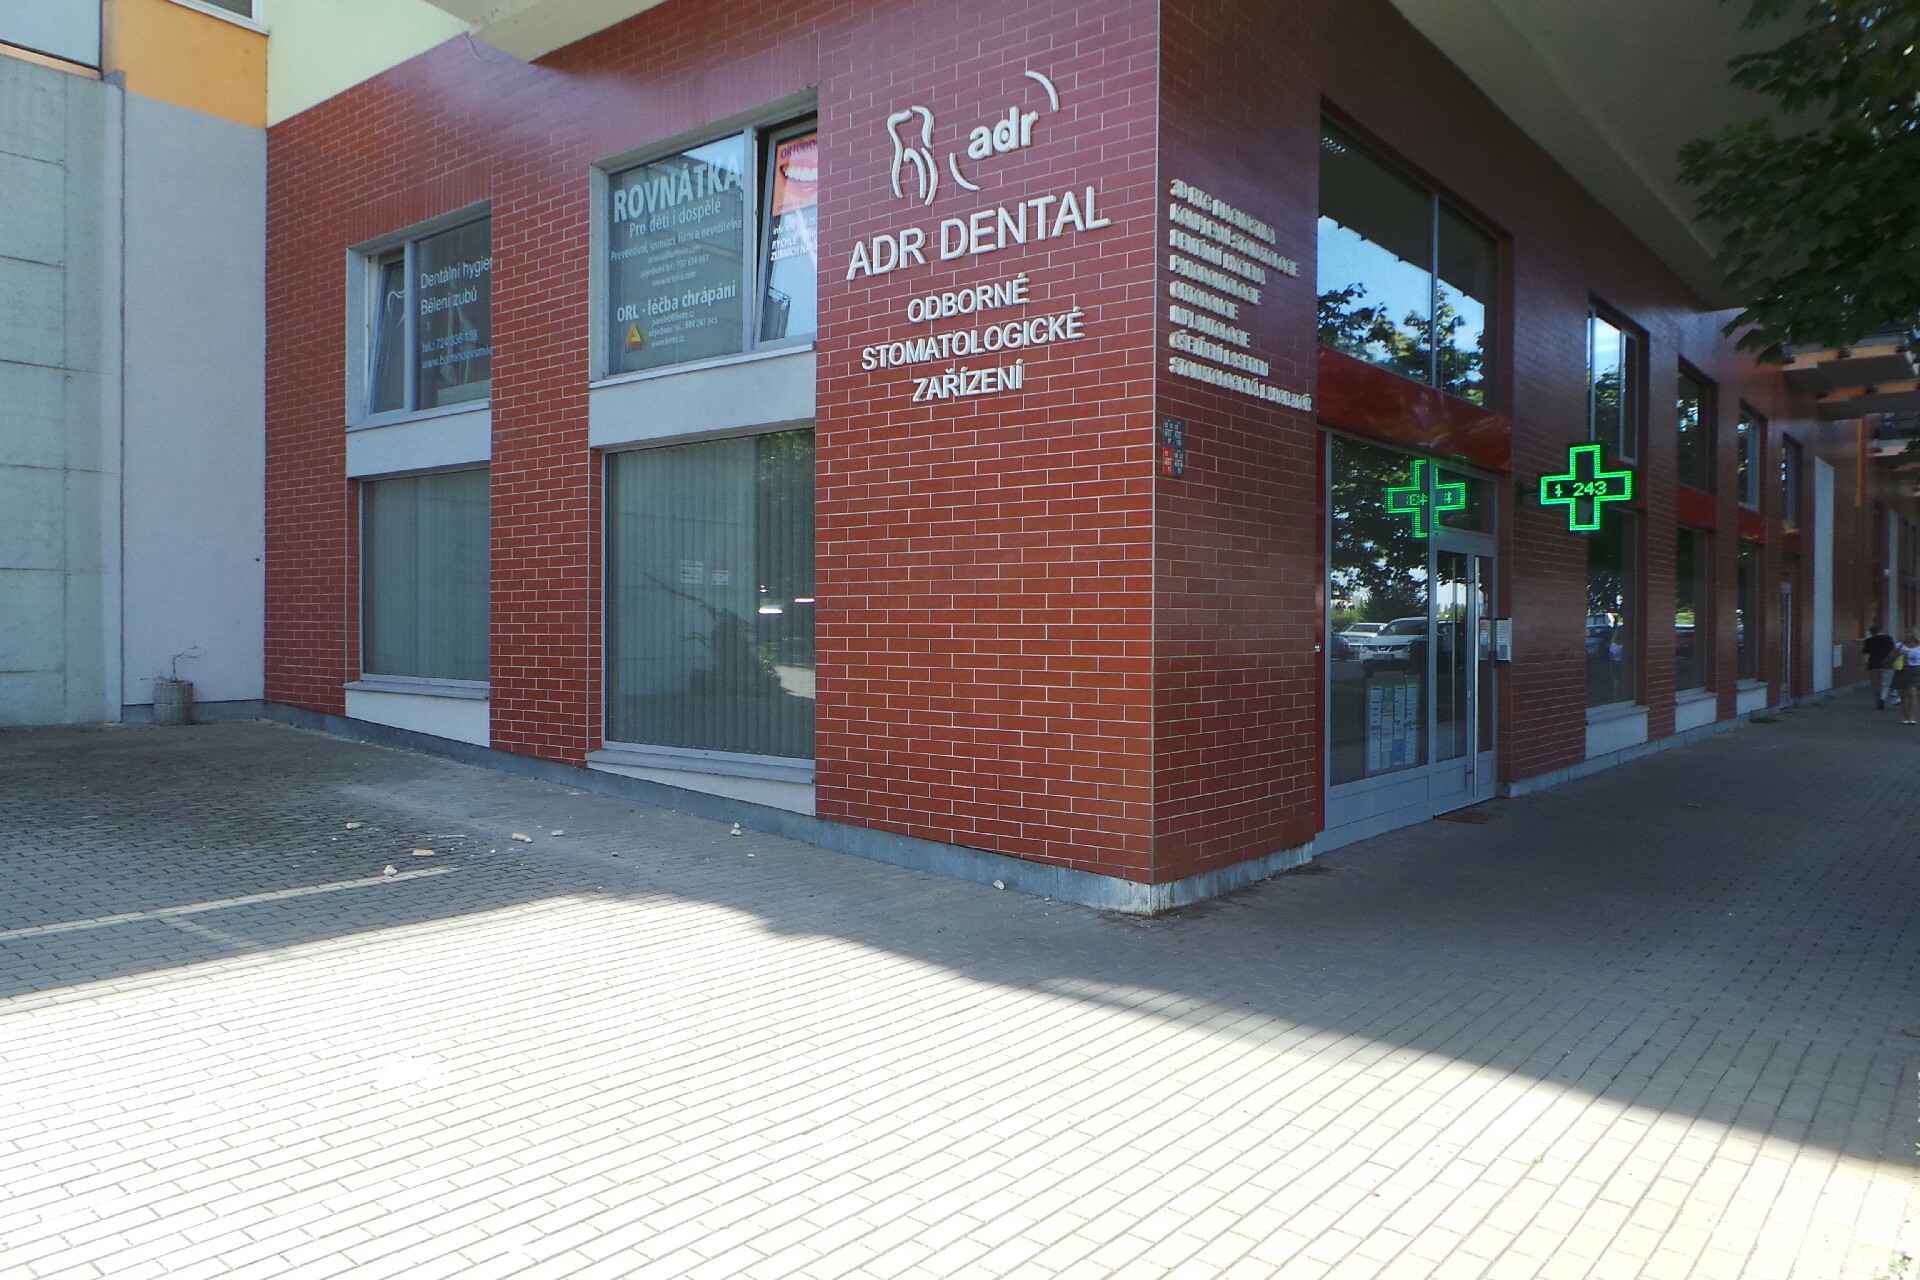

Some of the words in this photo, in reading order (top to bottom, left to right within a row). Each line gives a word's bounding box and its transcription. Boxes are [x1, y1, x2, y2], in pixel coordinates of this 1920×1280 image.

[967, 105, 1039, 161] adr
[614, 158, 744, 224] ROVNÁTKA
[629, 221, 647, 239] Pro
[649, 211, 669, 231] děti
[678, 198, 721, 225] dospělé
[845, 227, 928, 281] ADR
[940, 185, 1111, 261] DENTAL
[420, 262, 460, 289] Dentální
[907, 272, 1031, 324] ODBORNÉ
[420, 293, 451, 315] Bělení
[453, 285, 478, 307] zubů
[616, 306, 639, 323] ORL
[647, 291, 679, 316] léčba
[682, 280, 736, 309] chrápání
[861, 306, 1086, 371] STOMATOLOGICKÉ
[912, 358, 1024, 403] ZAŘÍZENÍ
[1572, 480, 1607, 497] 243
